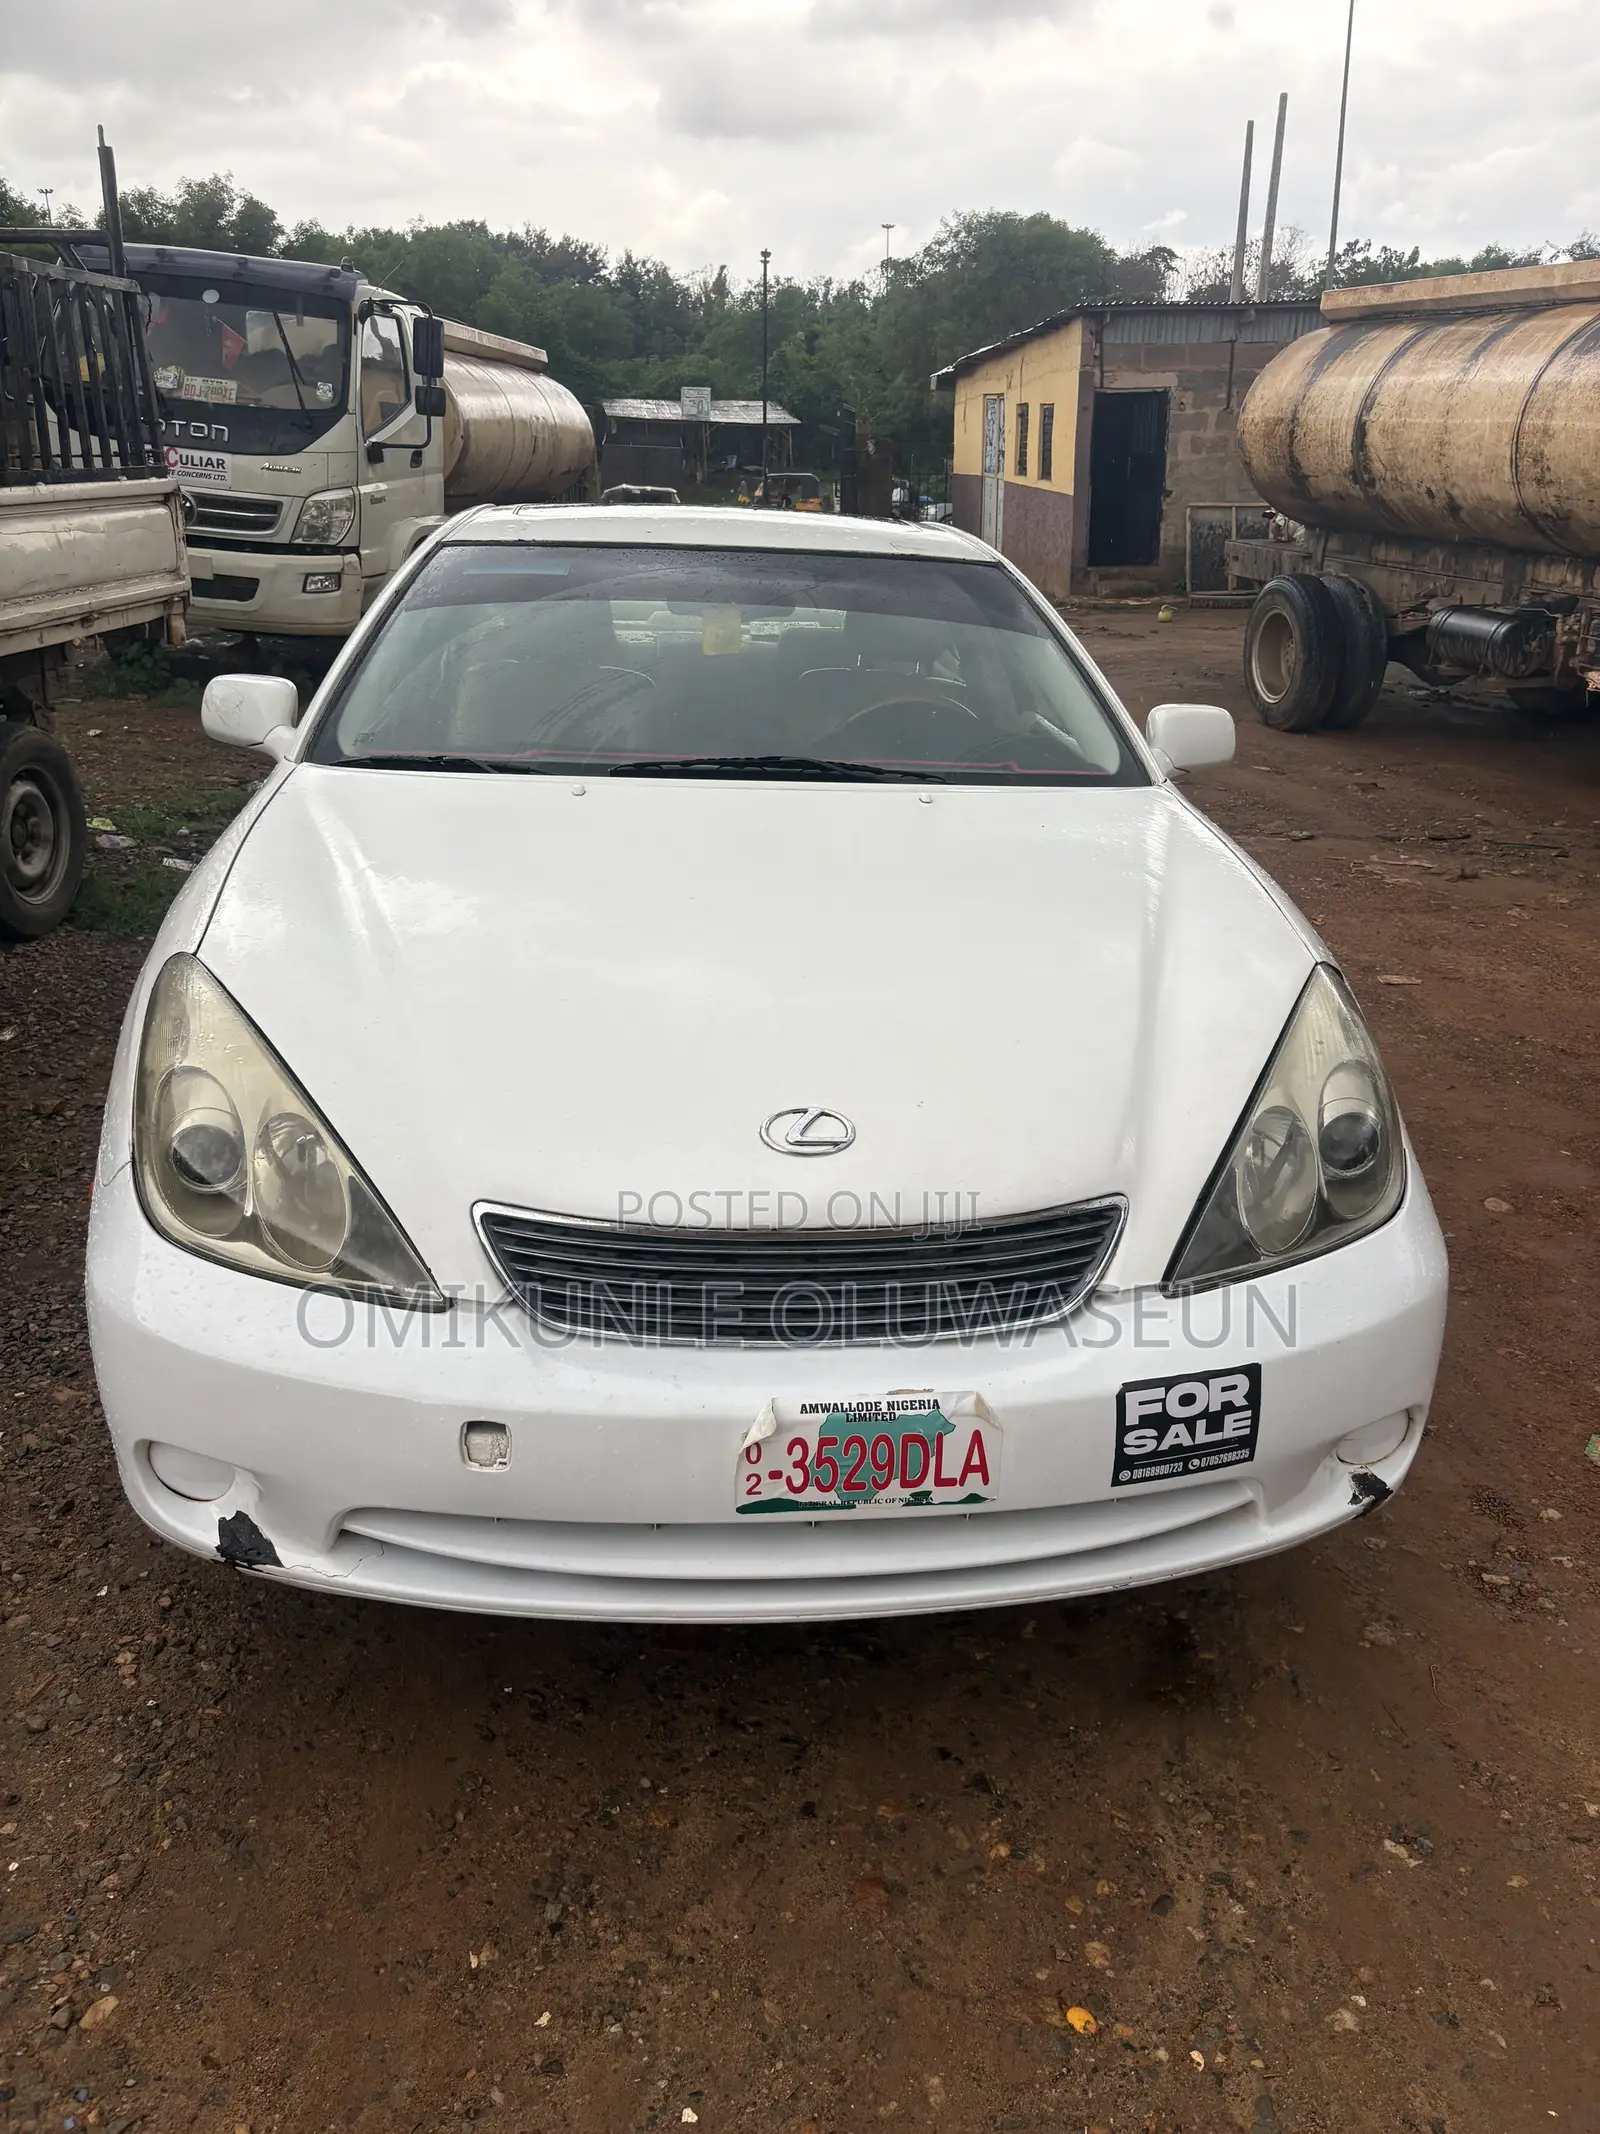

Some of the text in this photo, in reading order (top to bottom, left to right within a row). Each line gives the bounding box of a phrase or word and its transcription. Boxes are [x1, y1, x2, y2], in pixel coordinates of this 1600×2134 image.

[177, 470, 212, 479] CONCERNS
[1125, 1373, 1250, 1426] FOR
[799, 1399, 941, 1414] AMWALLODE NIGERIA
[845, 1411, 897, 1423] LIMITED
[1123, 1409, 1252, 1456] SALE
[840, 1498, 884, 1506] REPUBLIC
